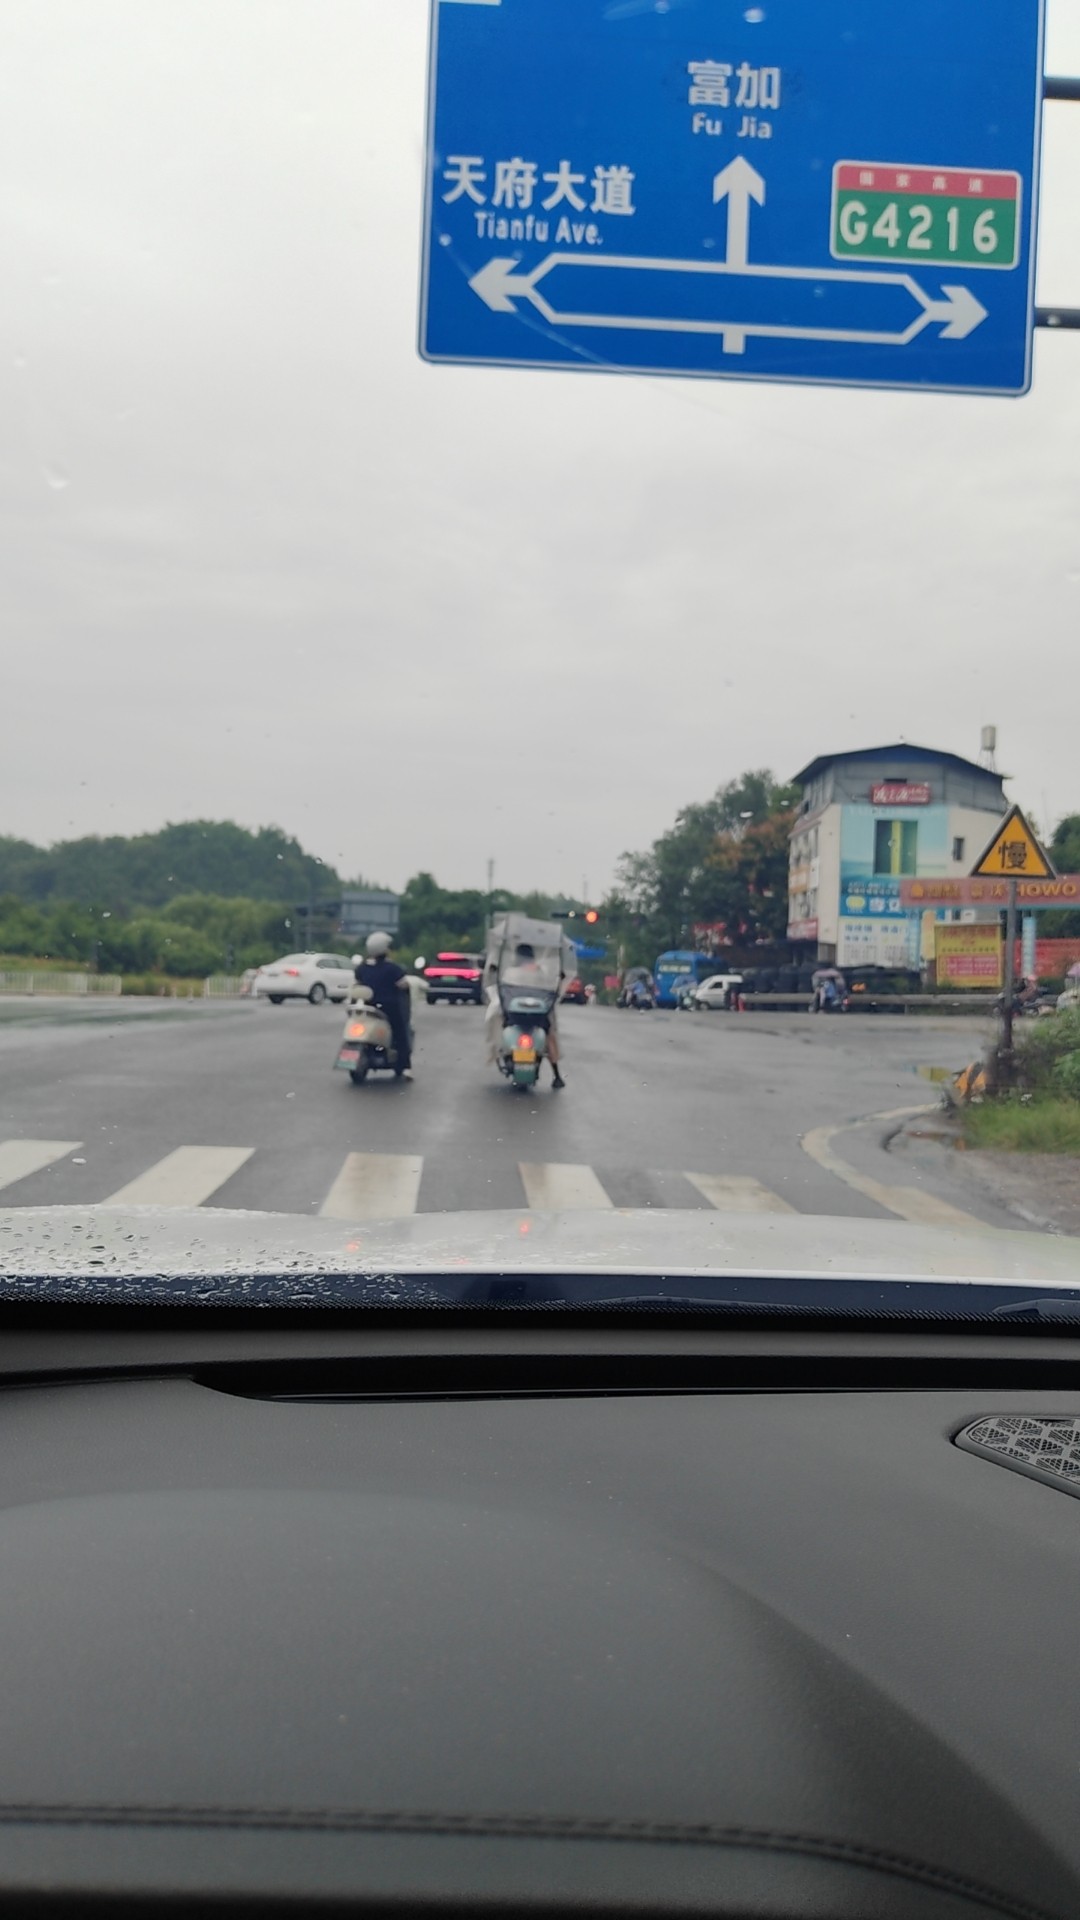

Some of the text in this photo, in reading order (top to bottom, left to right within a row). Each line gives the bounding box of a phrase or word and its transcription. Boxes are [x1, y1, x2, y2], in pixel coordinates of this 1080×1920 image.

[687, 60, 781, 109] 富加
[692, 112, 772, 140] Fu Jia
[442, 155, 636, 217] 天府大道
[474, 211, 603, 246] Tianfu Ave.
[839, 200, 998, 255] G4216
[998, 840, 1028, 870] 慢
